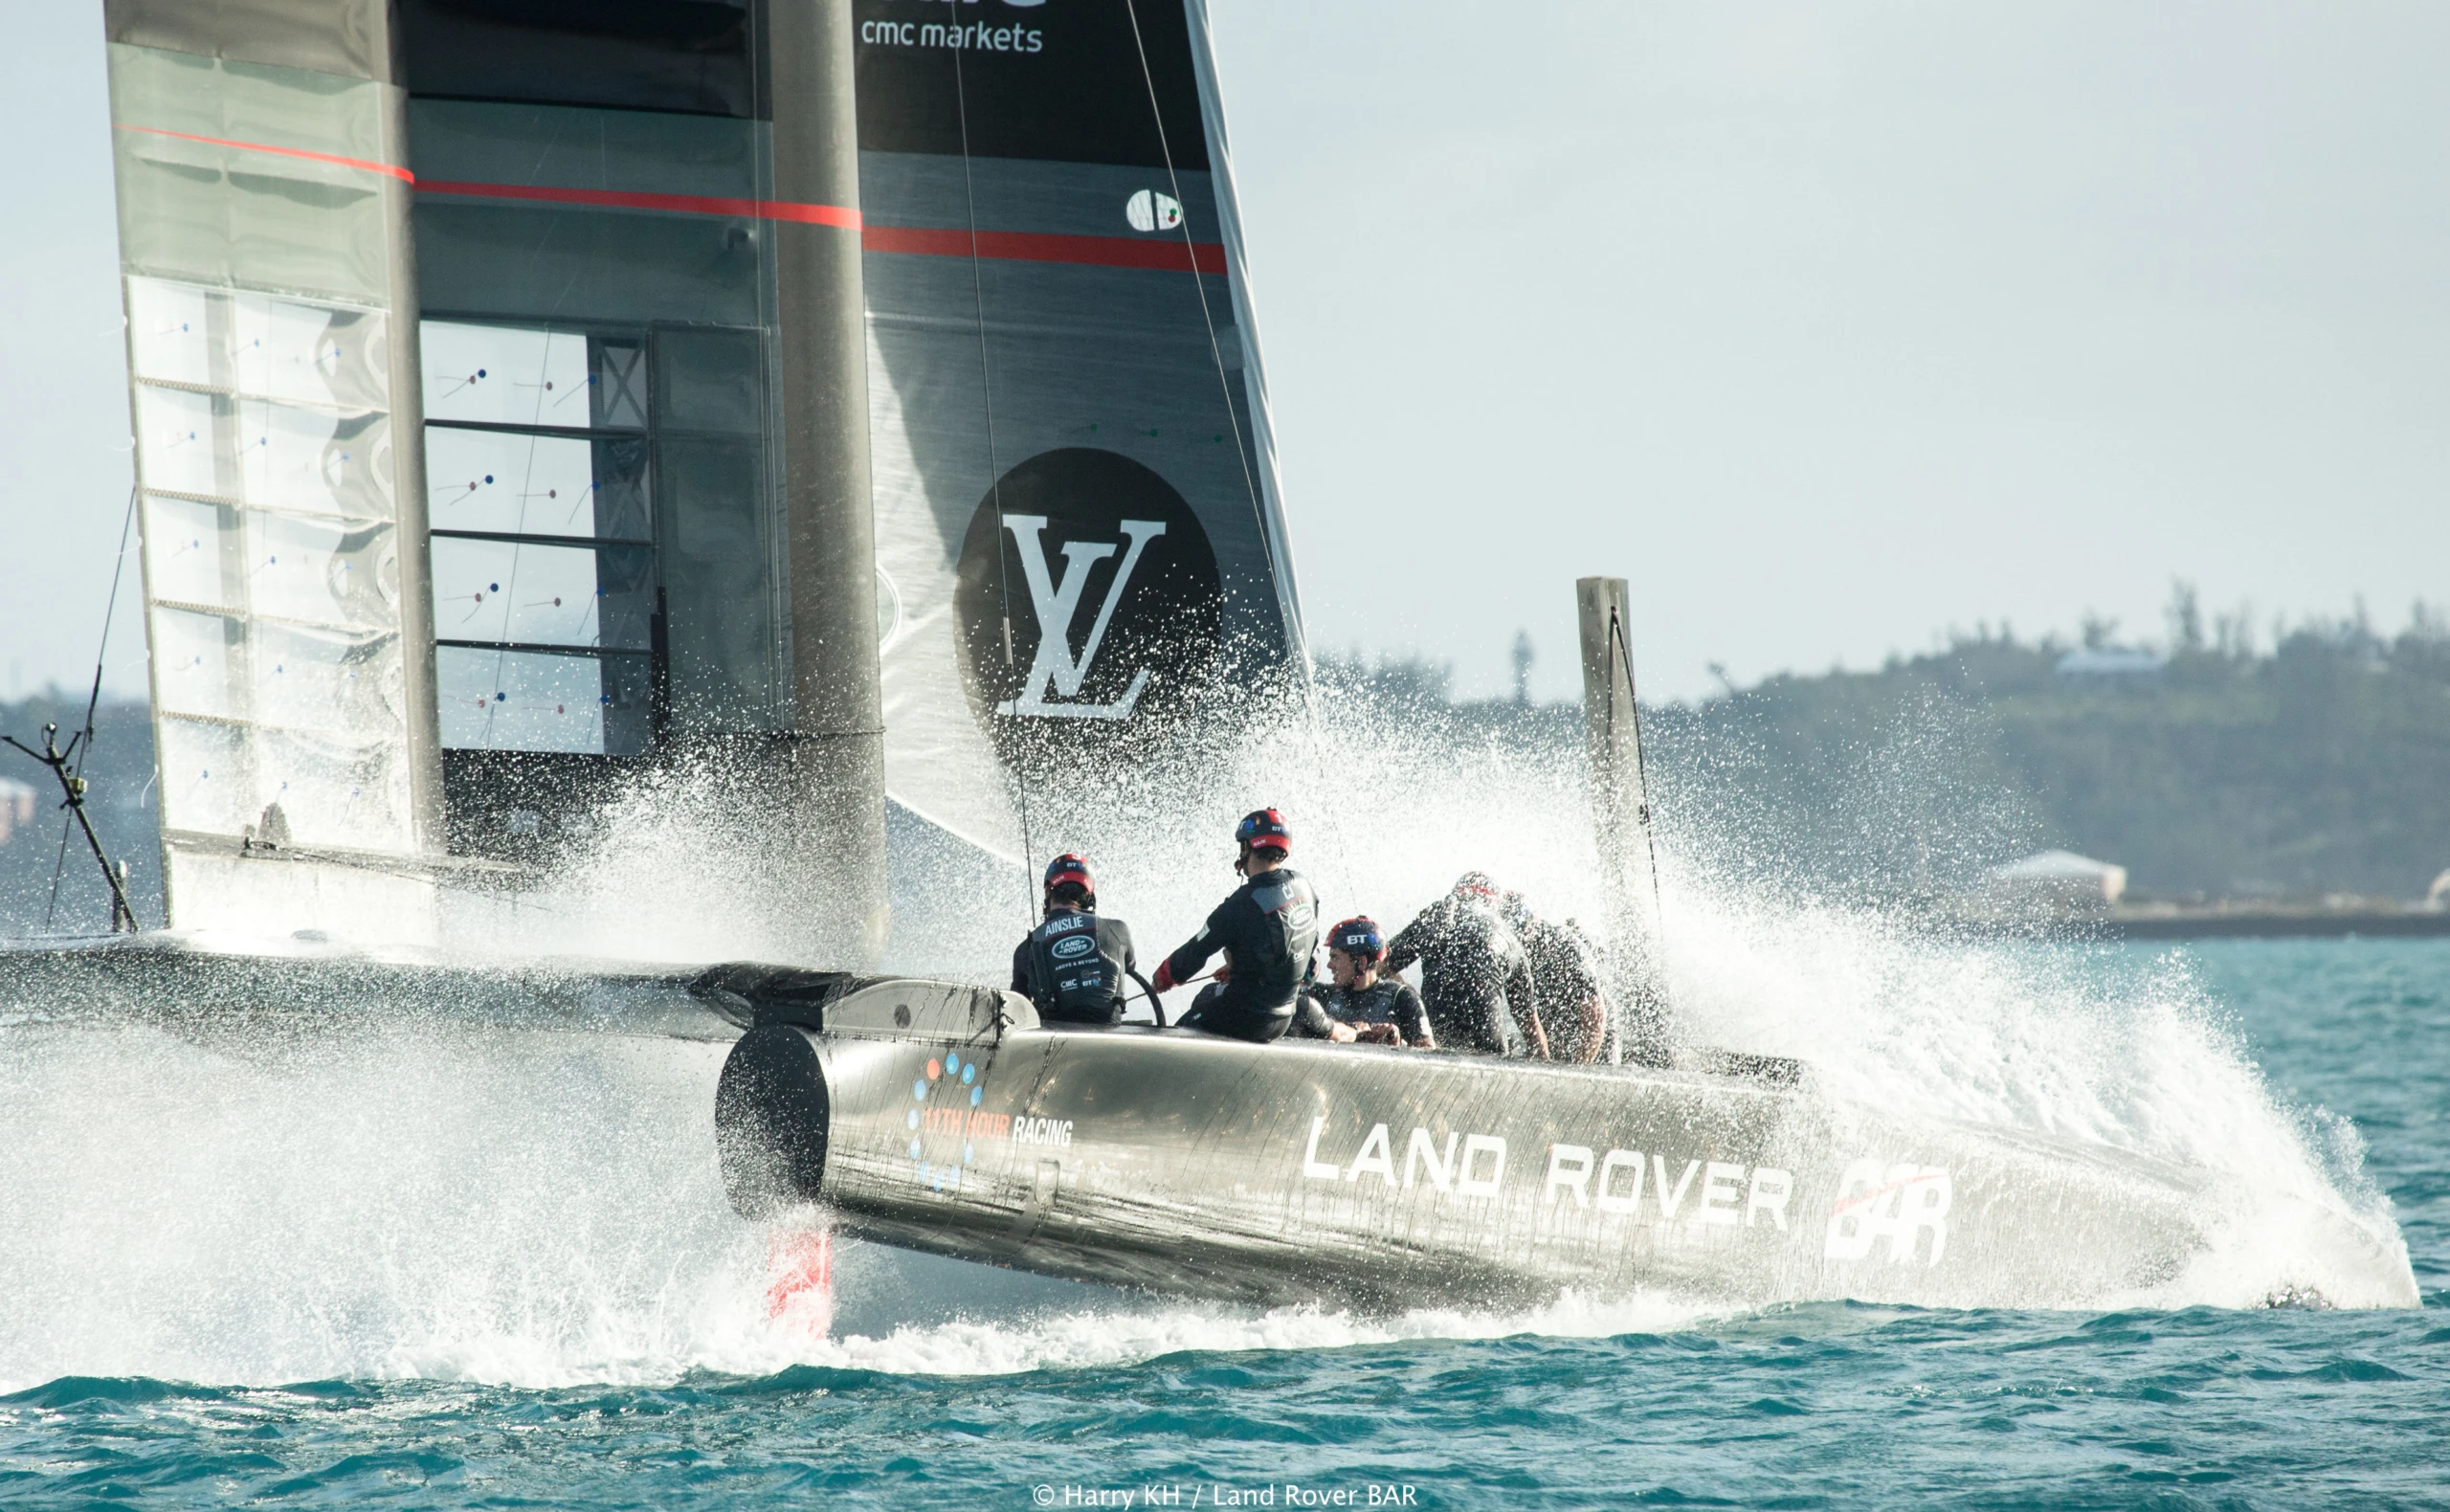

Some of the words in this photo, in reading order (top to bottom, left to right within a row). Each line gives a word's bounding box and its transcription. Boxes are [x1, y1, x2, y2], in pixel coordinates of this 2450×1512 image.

[861, 20, 915, 46] cmc
[921, 20, 1043, 53] markets
[1045, 916, 1083, 937] AINSLIE
[1347, 934, 1368, 945] BT
[1055, 962, 1072, 971] ABOVE
[924, 1107, 964, 1137] 11TH
[966, 1110, 1011, 1141] HOUR
[1013, 1116, 1074, 1147] RACING
[1303, 1116, 1507, 1197] LAND
[1545, 1144, 1794, 1233] ROVER
[1824, 1158, 1953, 1270] BAR
